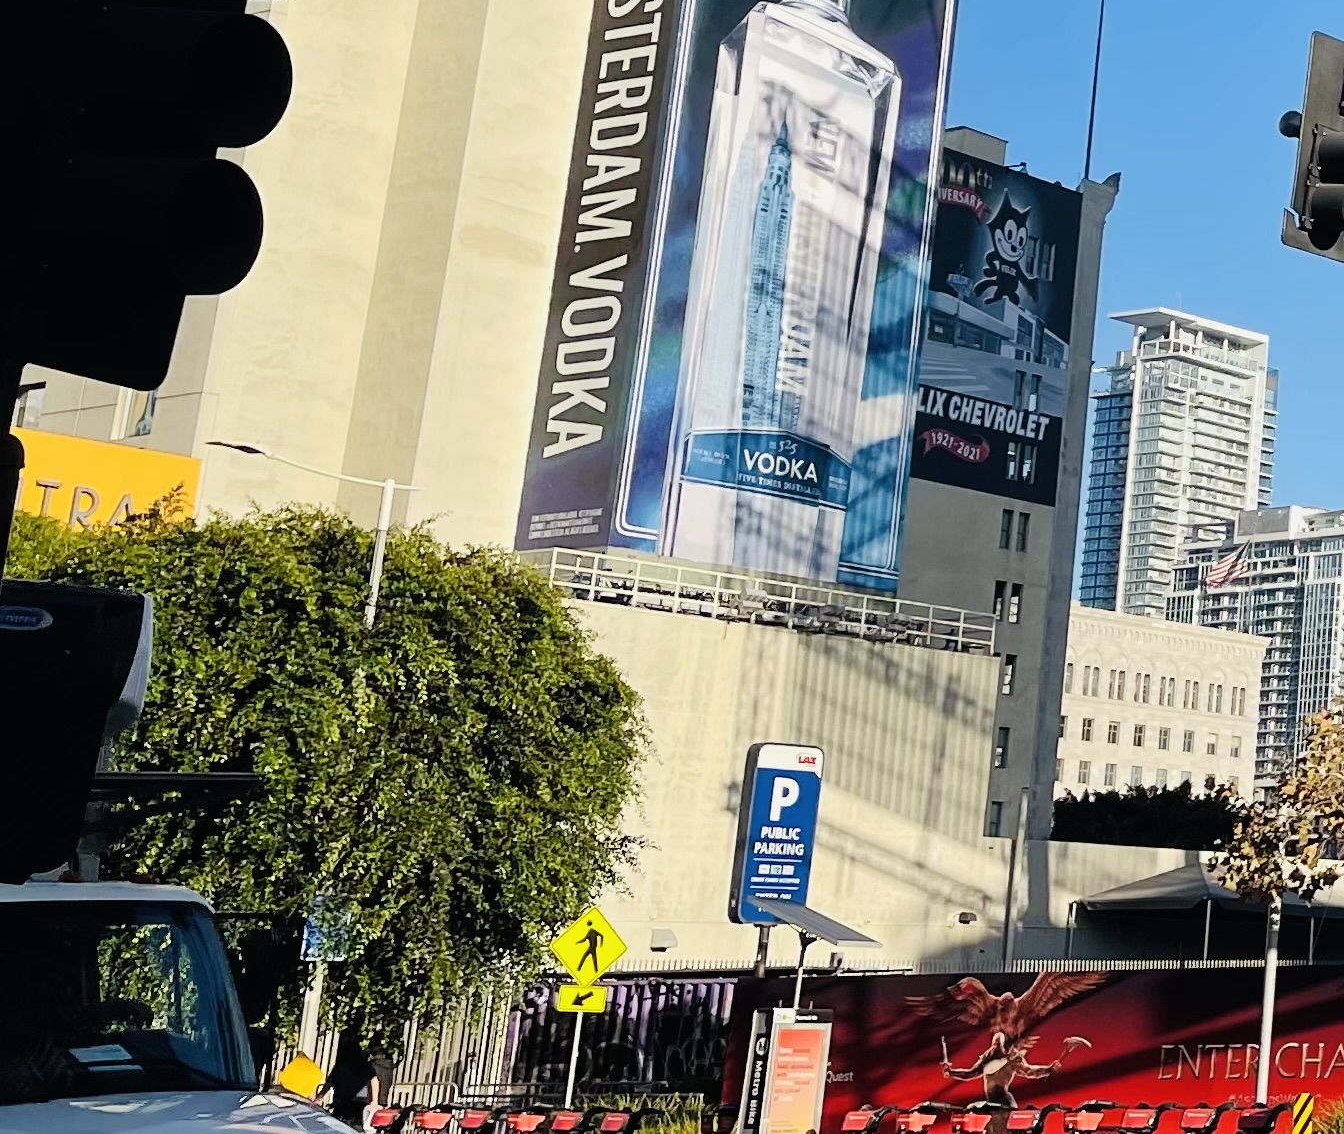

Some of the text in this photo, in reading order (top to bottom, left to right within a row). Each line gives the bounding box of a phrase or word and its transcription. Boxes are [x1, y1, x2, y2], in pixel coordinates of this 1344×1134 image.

[542, 253, 628, 459] VODKA
[948, 394, 1050, 441] CHEVROLET
[931, 431, 981, 462] 1921-2021
[743, 448, 819, 484] VODKA
[798, 755, 817, 765] LAZ
[769, 776, 800, 822] P
[753, 841, 805, 857] PARKING
[760, 826, 802, 841] PUBLIC
[826, 1070, 854, 1084] Quest
[1157, 1043, 1261, 1080] ENTER
[747, 1060, 764, 1125] Metro Bike
